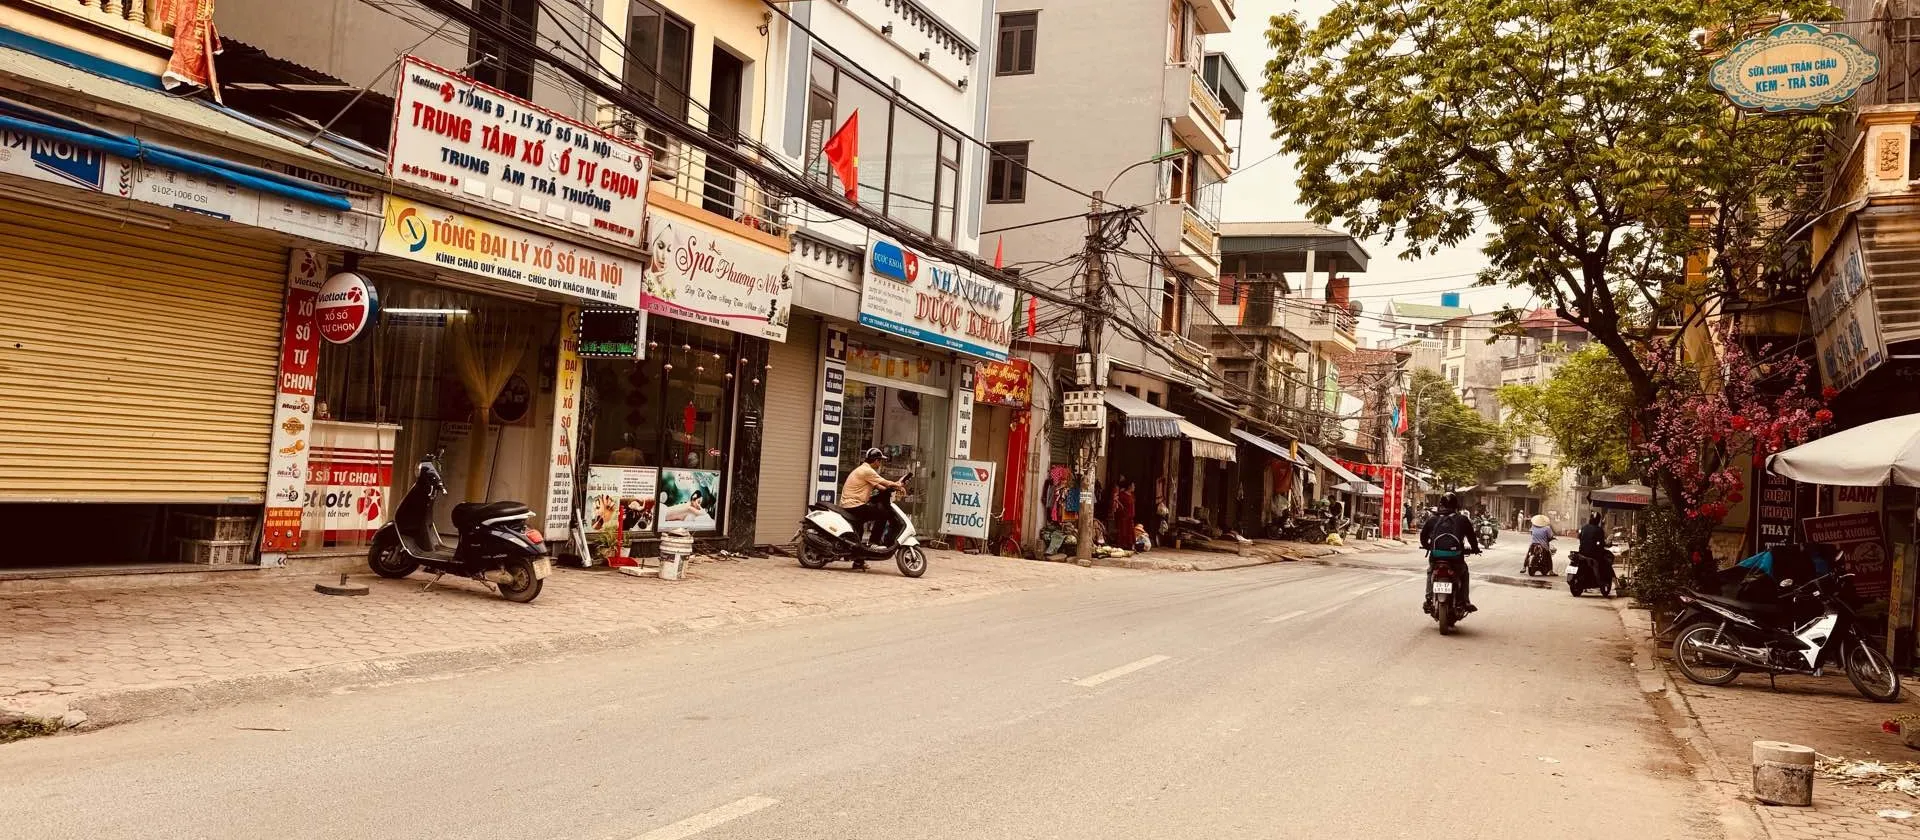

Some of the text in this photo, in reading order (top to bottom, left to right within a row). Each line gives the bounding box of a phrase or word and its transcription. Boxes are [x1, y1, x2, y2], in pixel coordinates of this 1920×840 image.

[1748, 66, 1764, 78] SỮA
[1791, 60, 1812, 73] TRÂN
[1815, 58, 1837, 70] CHÂU
[1755, 79, 1778, 93] KEM
[1787, 74, 1807, 90] TRÀ
[1809, 73, 1830, 88] SỮA
[520, 112, 535, 129] LÝ
[556, 127, 572, 143] SỐ
[574, 132, 589, 149] HÀ
[592, 139, 612, 159] NỘI
[412, 100, 473, 144] TRUNG
[481, 124, 518, 158] TÂM
[577, 158, 599, 187] TỰ
[600, 167, 639, 200] CHỌN
[441, 146, 490, 175] TRUNG
[530, 176, 556, 197] TRẢ
[193, 194, 208, 204] ISO
[432, 214, 623, 289] TỔNG ĐẠI LÝ XỔ SỐ HÀ NỘI
[675, 235, 715, 281] Spa
[435, 251, 456, 265] KÍNH
[457, 257, 479, 270] CHÀO
[497, 266, 522, 280] KHÁCH
[528, 272, 547, 286] CHÚC
[563, 280, 585, 294] KHÁCH
[585, 286, 600, 298] MAY
[336, 308, 349, 320] SỐ
[914, 292, 962, 333] DƯỢC
[295, 321, 312, 342] SỐ
[332, 322, 355, 333] CHỌN
[563, 336, 577, 352] TỔN
[293, 349, 309, 369] TỰ
[283, 371, 313, 393] CHỌN
[333, 471, 348, 485] TỰ
[349, 472, 377, 486] CHỌN
[951, 491, 981, 508] NHÀ
[945, 511, 984, 529] THUỐC
[1760, 524, 1791, 536] THAY
